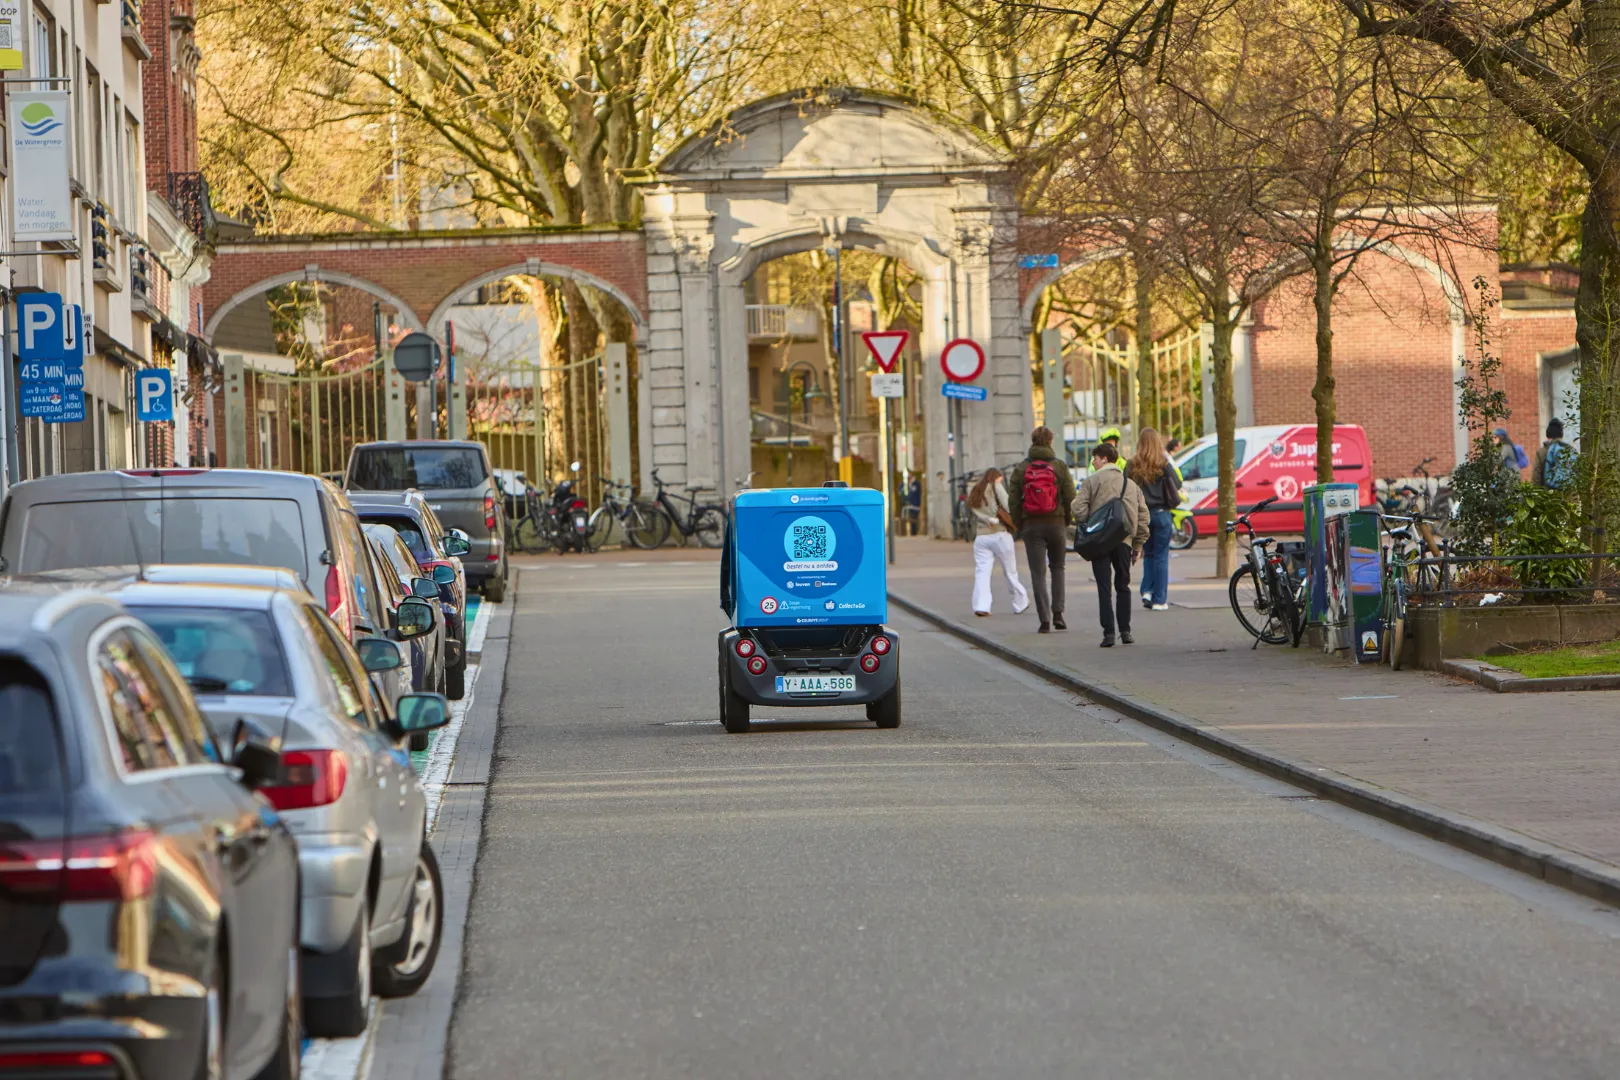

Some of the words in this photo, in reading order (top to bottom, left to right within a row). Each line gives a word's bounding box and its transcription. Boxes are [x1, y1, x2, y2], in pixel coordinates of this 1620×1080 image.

[24, 139, 62, 147] Watergroep
[19, 209, 56, 220] Vandaag
[32, 221, 68, 232] morgen.
[23, 303, 56, 350] P
[21, 364, 40, 379] 45
[44, 365, 63, 379] MIN
[64, 373, 83, 386] MIN
[34, 386, 39, 394] 9
[141, 376, 166, 413] P
[31, 405, 63, 414] ZATERDAG
[1269, 460, 1305, 468] PARTNERS
[764, 601, 774, 610] 25
